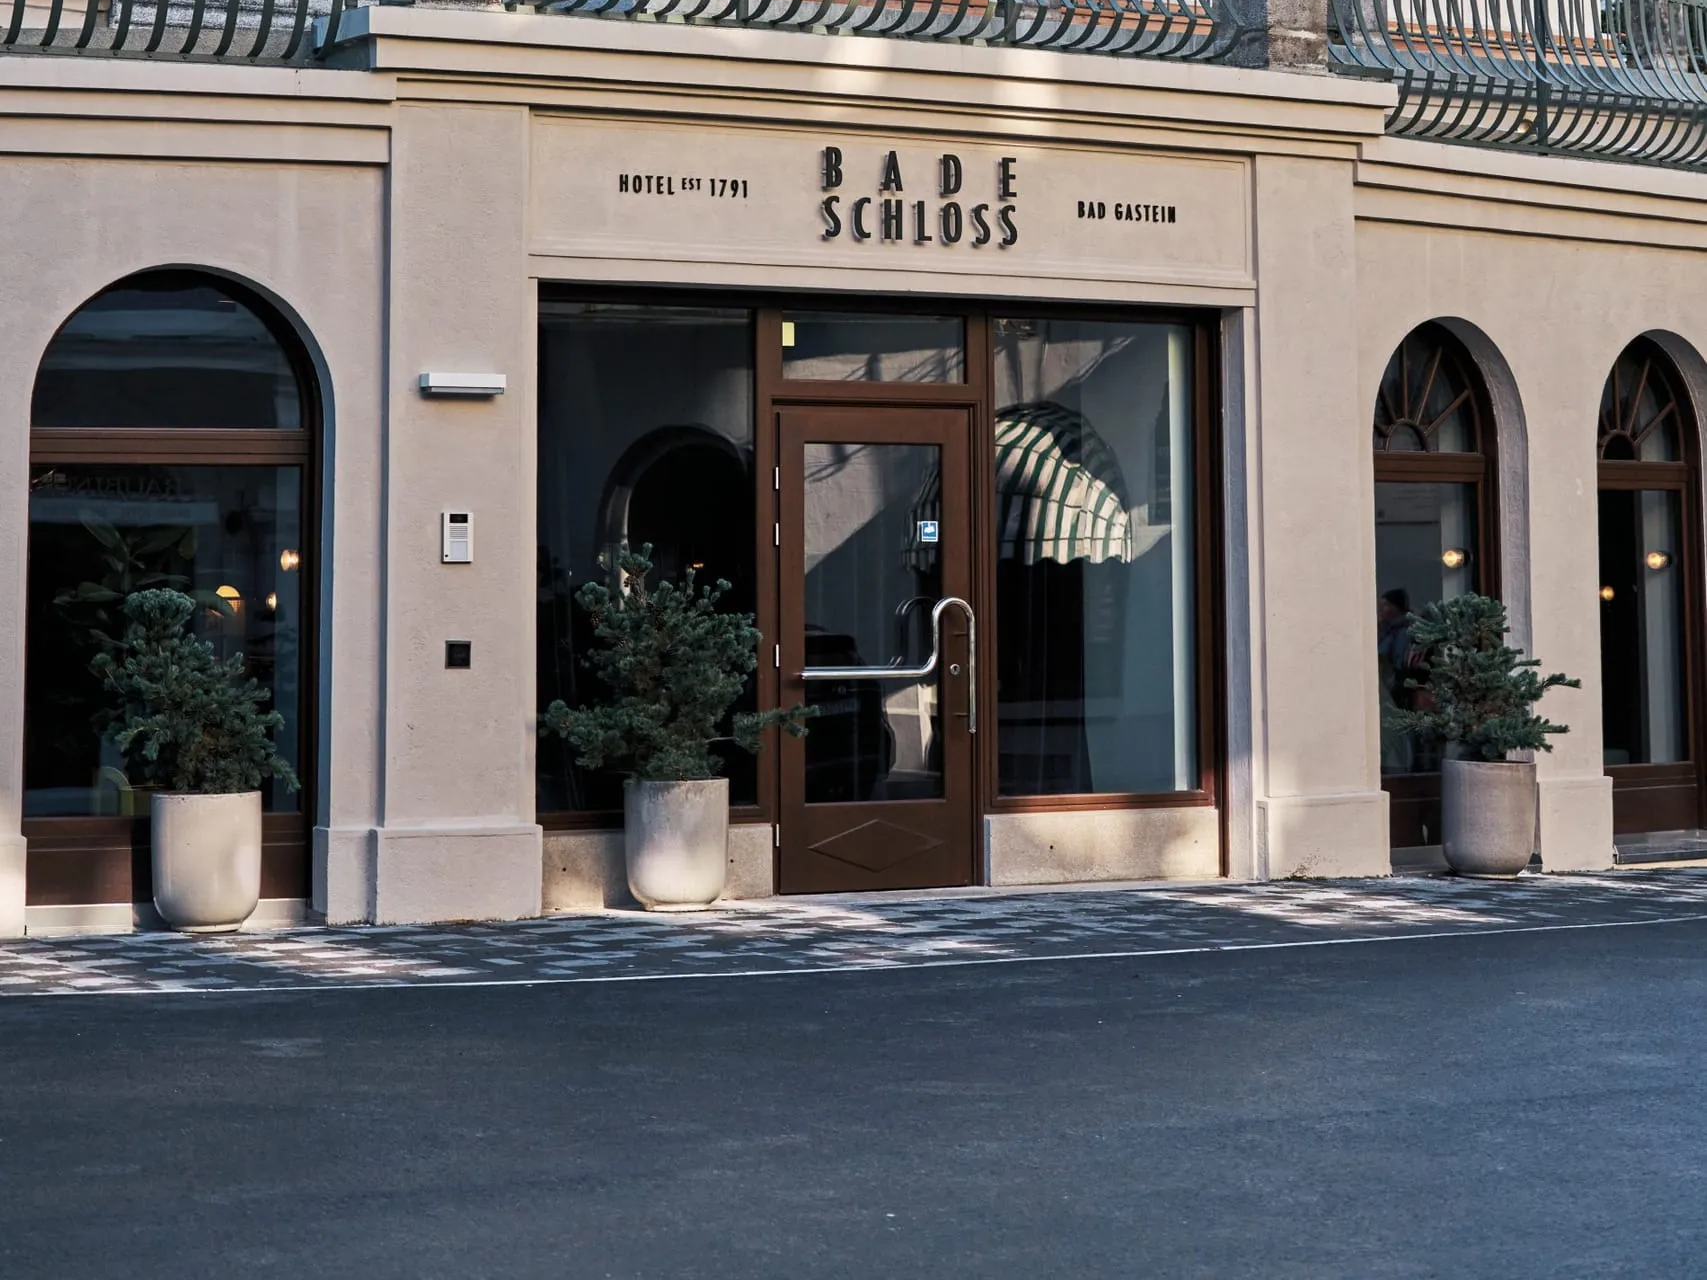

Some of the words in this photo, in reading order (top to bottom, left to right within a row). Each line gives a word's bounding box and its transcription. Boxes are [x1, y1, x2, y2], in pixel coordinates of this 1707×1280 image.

[619, 174, 675, 195] HOTEL
[681, 177, 702, 190] EST
[710, 178, 748, 198] 1791
[823, 146, 1017, 198] BADE
[822, 195, 1018, 246] SCHLOSS
[1077, 201, 1106, 219] BAD
[1114, 203, 1176, 223] GASTEIN
